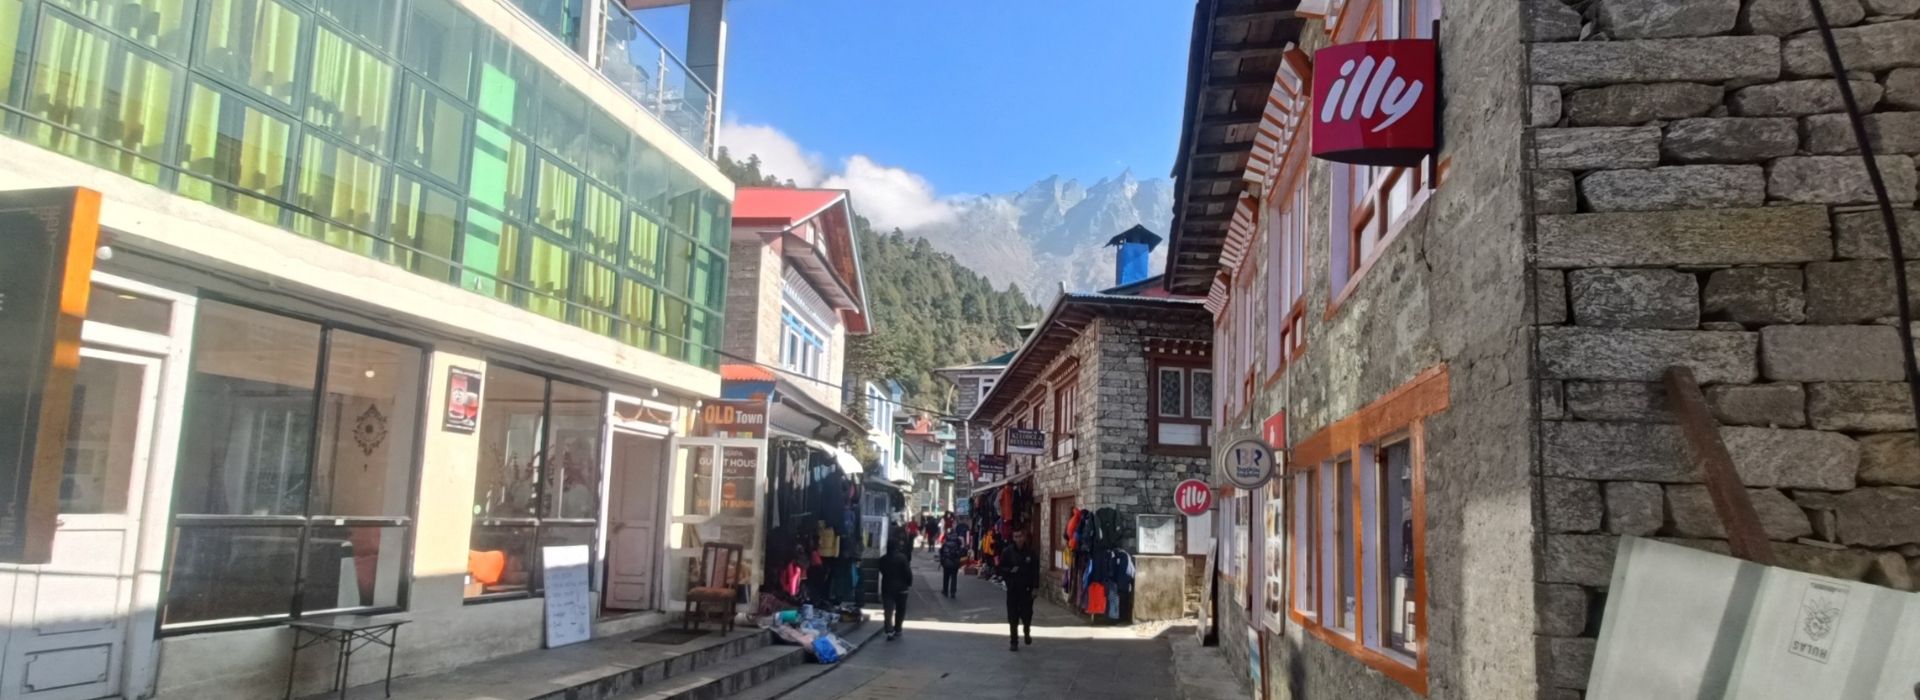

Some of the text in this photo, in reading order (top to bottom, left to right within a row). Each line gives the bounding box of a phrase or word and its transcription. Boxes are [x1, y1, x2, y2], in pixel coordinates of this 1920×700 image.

[1321, 55, 1423, 133] illy
[704, 404, 763, 424] OLD Town
[730, 458, 757, 468] HOUS
[1182, 485, 1207, 509] illy
[1792, 640, 1828, 659] HULAS
